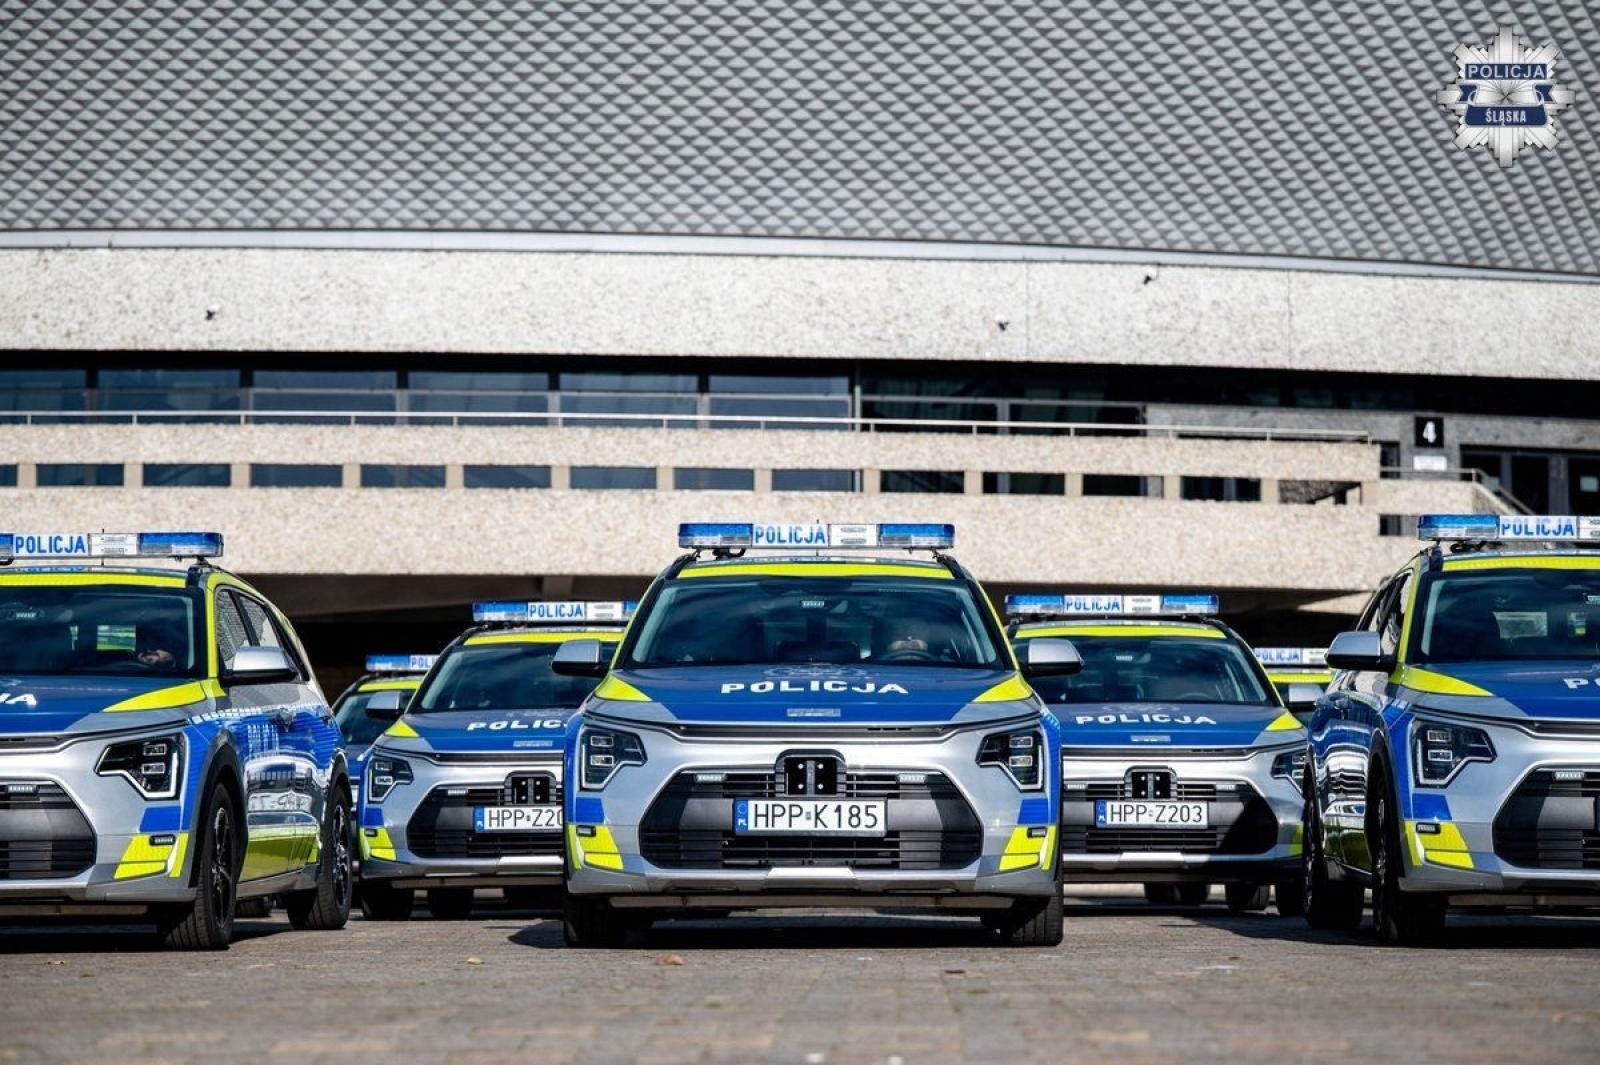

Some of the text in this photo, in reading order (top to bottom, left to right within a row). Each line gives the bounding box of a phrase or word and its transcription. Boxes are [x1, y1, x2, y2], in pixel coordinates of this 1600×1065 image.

[1423, 420, 1436, 443] 4
[755, 525, 826, 544] POLICJA
[1501, 516, 1574, 536] POLICJA
[15, 535, 86, 554] POLICJA
[529, 603, 583, 618] POLICJA
[1066, 596, 1120, 612] POLICJA
[721, 680, 909, 694] POLICJA
[467, 719, 567, 731] POLIC
[1075, 713, 1217, 725] POLICJA
[488, 808, 525, 827] HPP
[754, 803, 878, 829] HPP K185
[1110, 804, 1203, 823] HPP Z203
